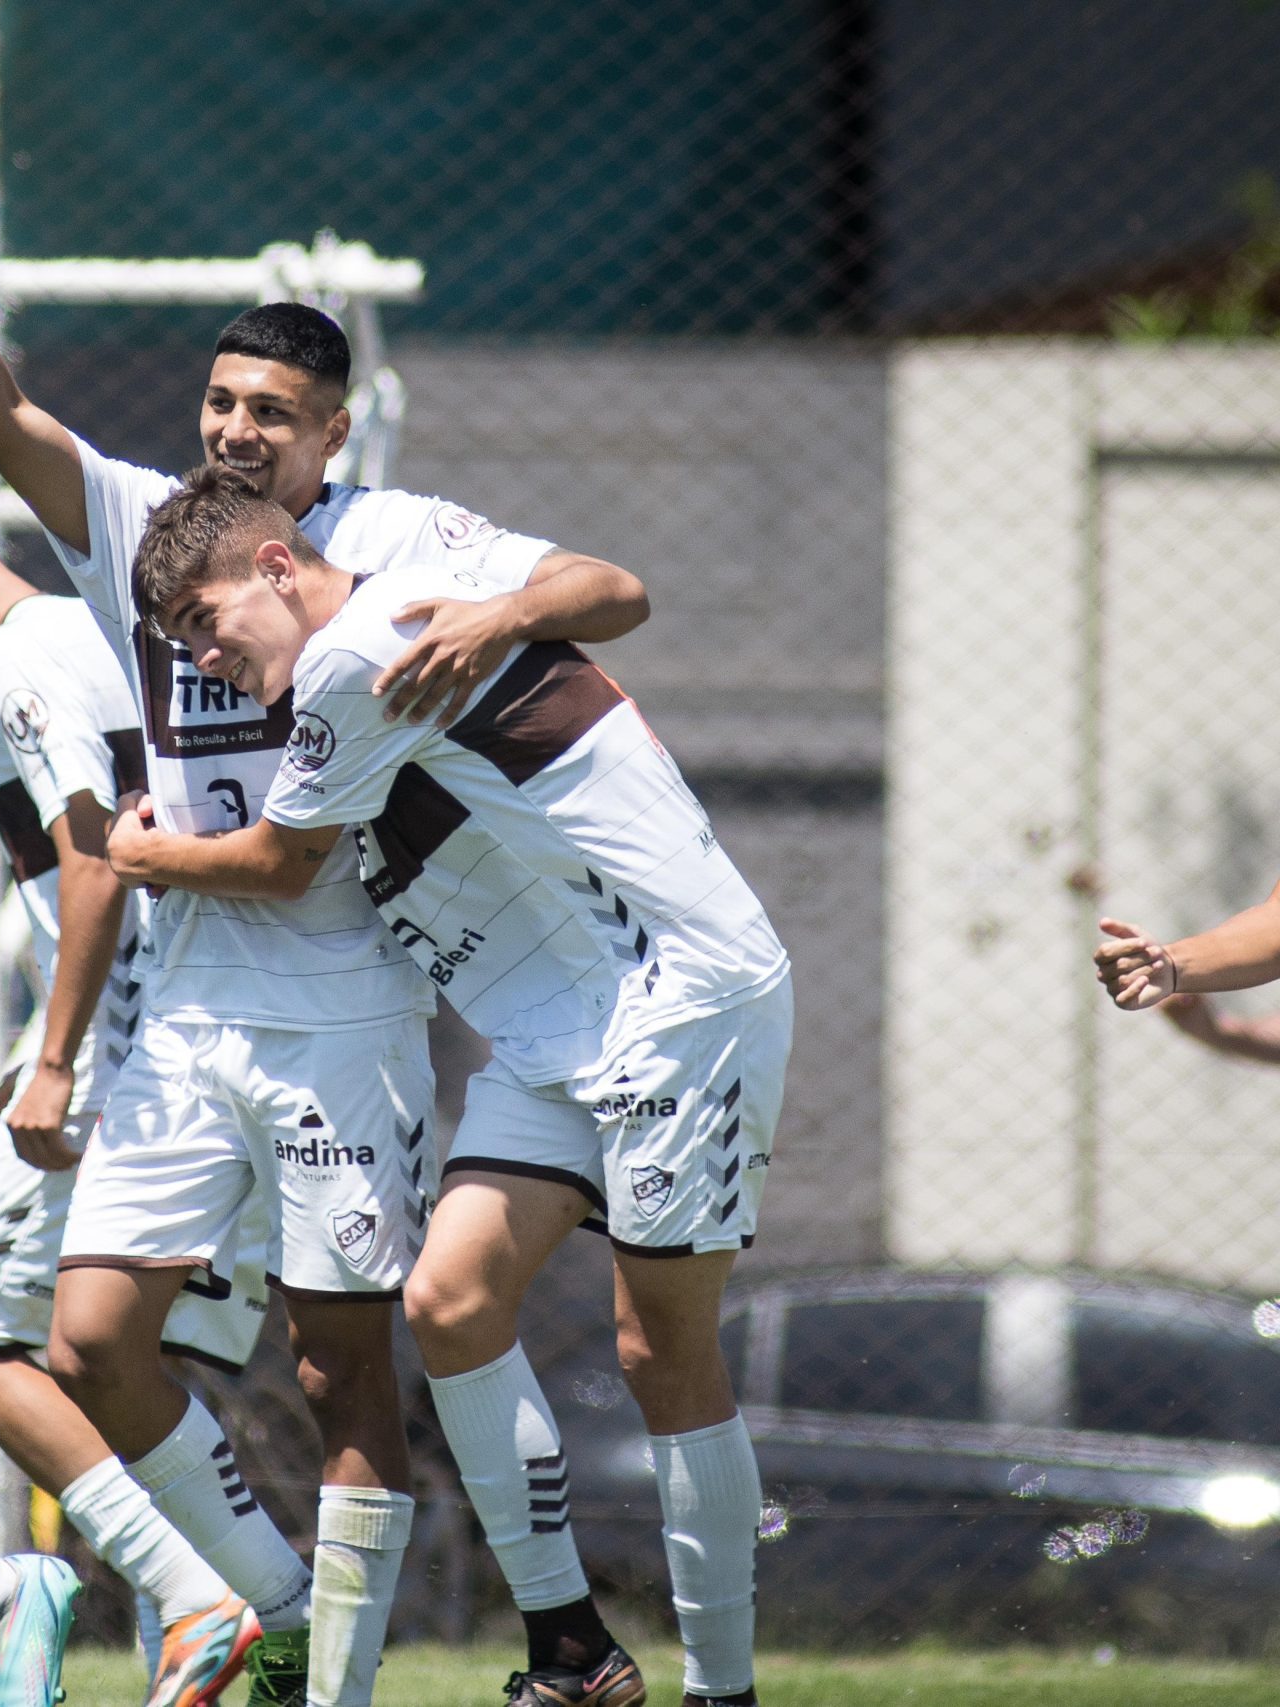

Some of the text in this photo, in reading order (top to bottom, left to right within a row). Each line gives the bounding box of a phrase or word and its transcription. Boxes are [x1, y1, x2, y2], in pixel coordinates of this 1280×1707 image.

[176, 675, 249, 713] TRF
[192, 733, 226, 746] Resulta
[238, 729, 264, 742] Fácil
[429, 927, 486, 987] gieri
[274, 1138, 375, 1167] andina
[296, 1169, 342, 1183] PNTURAS
[340, 1219, 369, 1247] CAP
